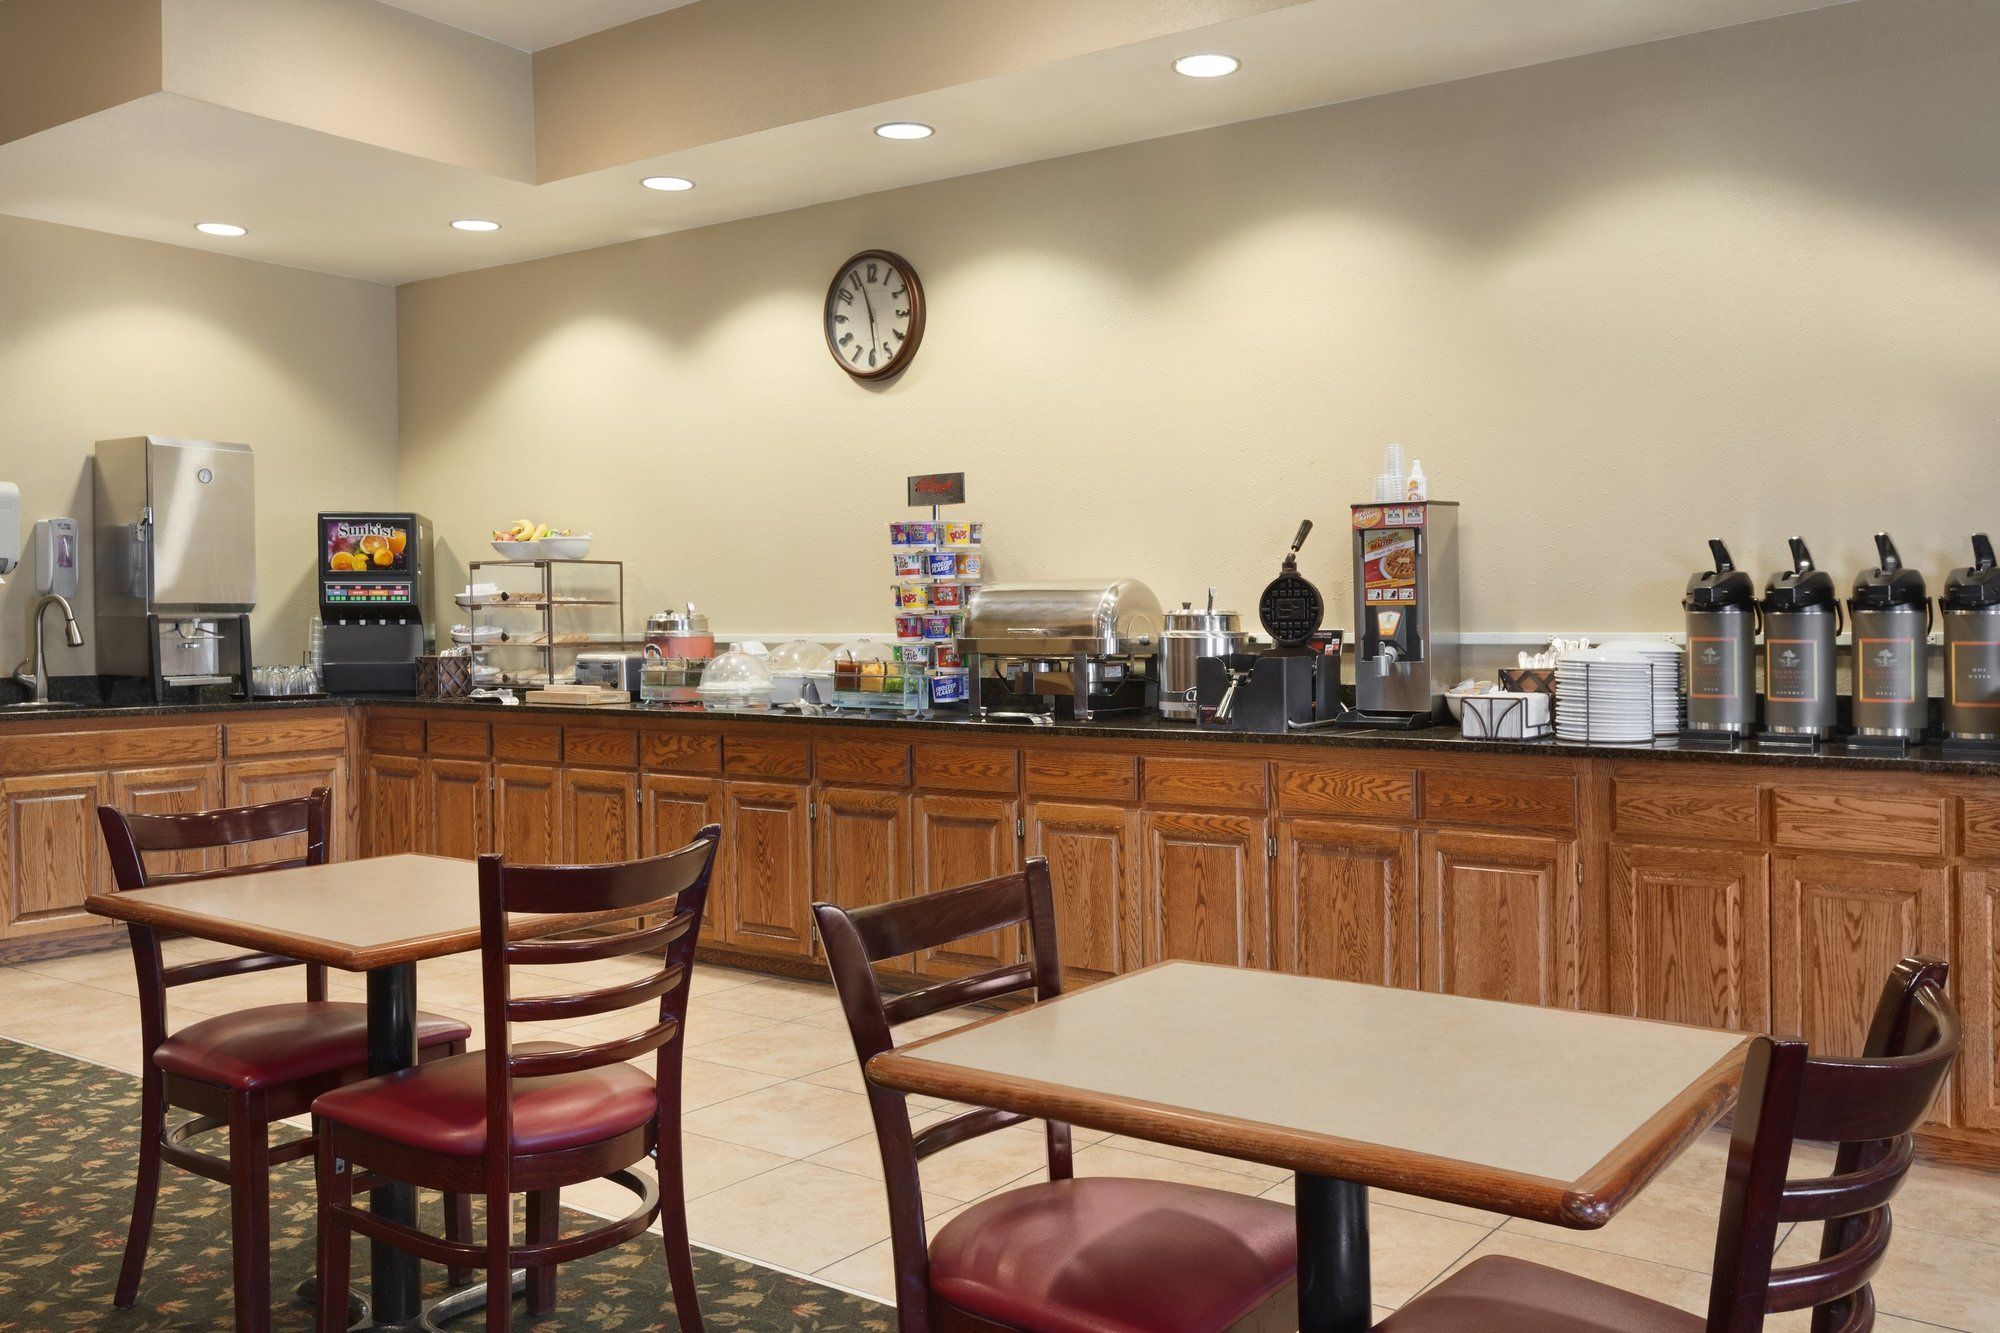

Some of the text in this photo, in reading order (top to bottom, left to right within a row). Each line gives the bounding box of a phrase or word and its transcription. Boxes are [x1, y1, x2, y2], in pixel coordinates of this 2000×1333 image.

[849, 270, 864, 291] 11
[866, 263, 877, 283] 12
[882, 267, 893, 286] 1
[837, 288, 853, 306] 10
[891, 283, 907, 299] 2
[834, 314, 849, 325] 9
[895, 308, 910, 319] 3
[839, 332, 854, 348] 8
[892, 328, 906, 342] 4
[852, 344, 864, 363] 7
[868, 348, 876, 367] 6
[883, 341, 893, 360] 5
[338, 522, 395, 538] Sunkist
[949, 529, 967, 543] POPS
[931, 560, 953, 570] FROSTED
[936, 683, 957, 693] FROSTED
